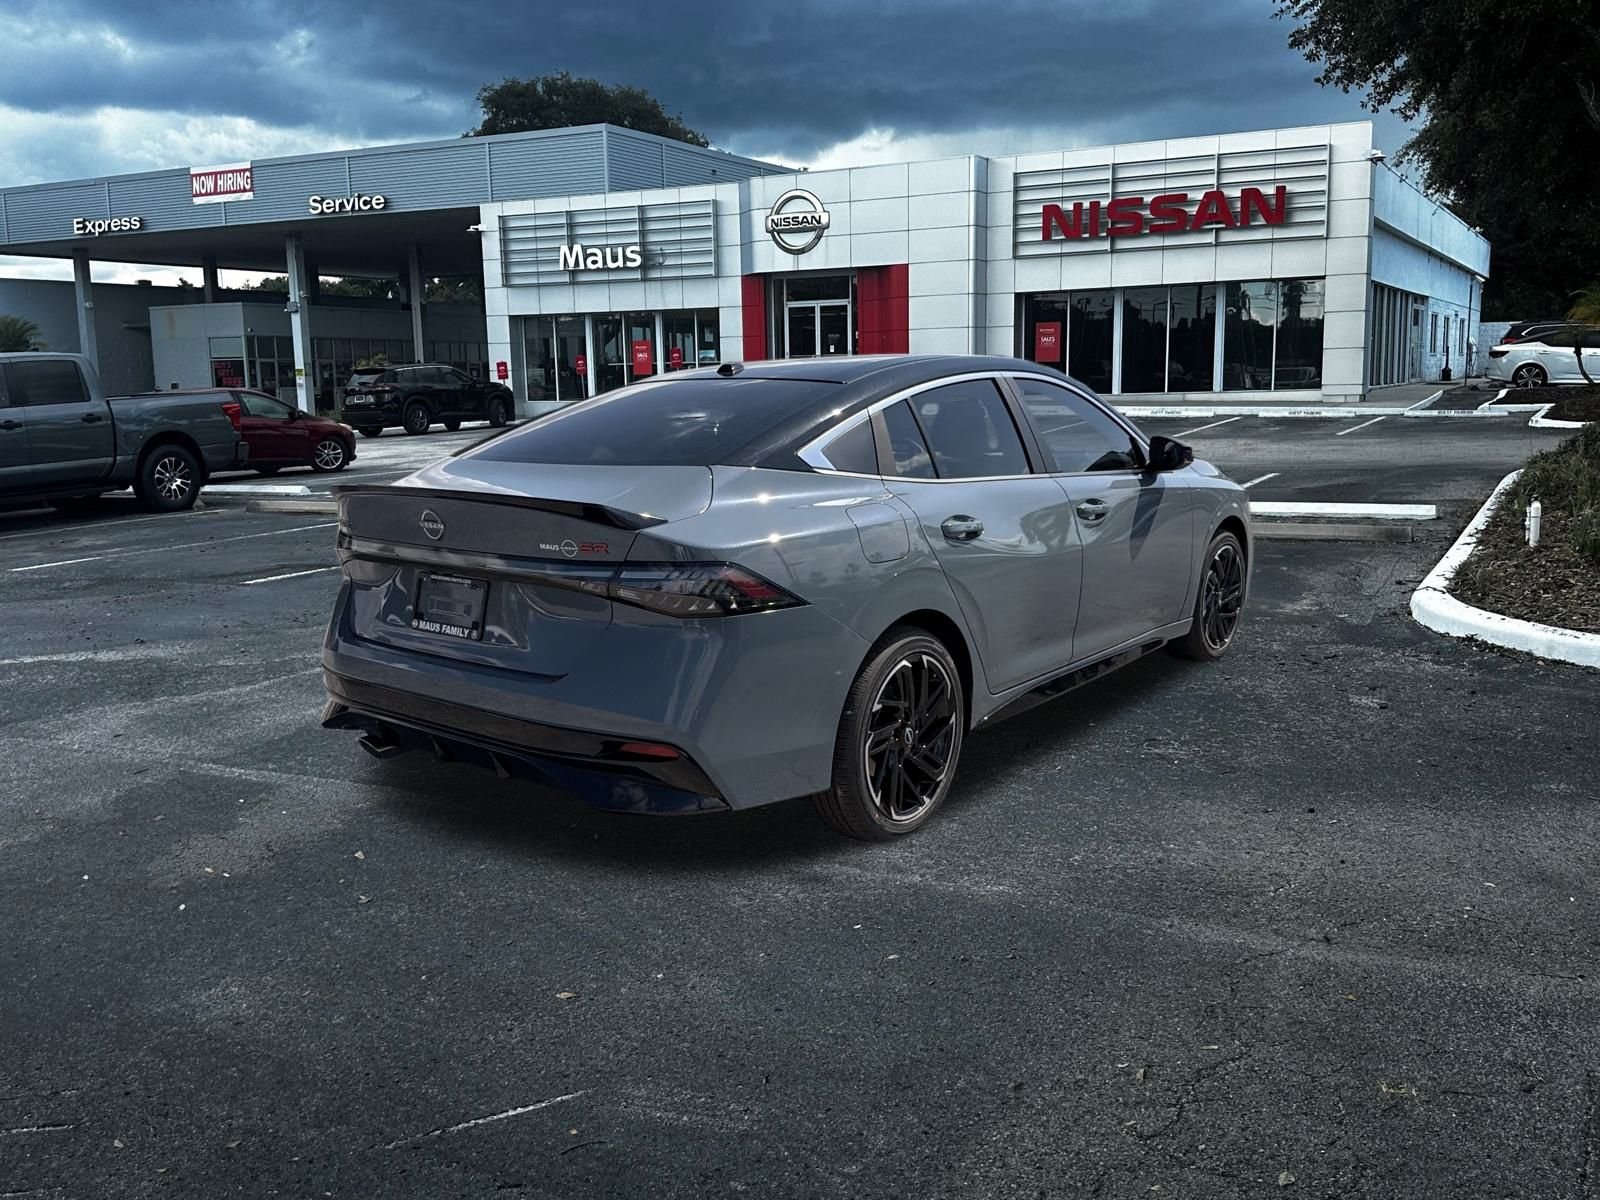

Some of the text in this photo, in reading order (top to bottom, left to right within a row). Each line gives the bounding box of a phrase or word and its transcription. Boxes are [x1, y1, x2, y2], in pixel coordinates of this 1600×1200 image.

[192, 171, 251, 195] NOW HIRING
[309, 193, 385, 214] Service
[1042, 185, 1287, 241] NISSAN
[73, 216, 141, 236] Express
[770, 214, 822, 228] NISSAN
[560, 243, 642, 270] Maus
[540, 543, 560, 551] MAUS
[580, 543, 608, 553] SR
[418, 620, 470, 638] MAUS FAMILY
